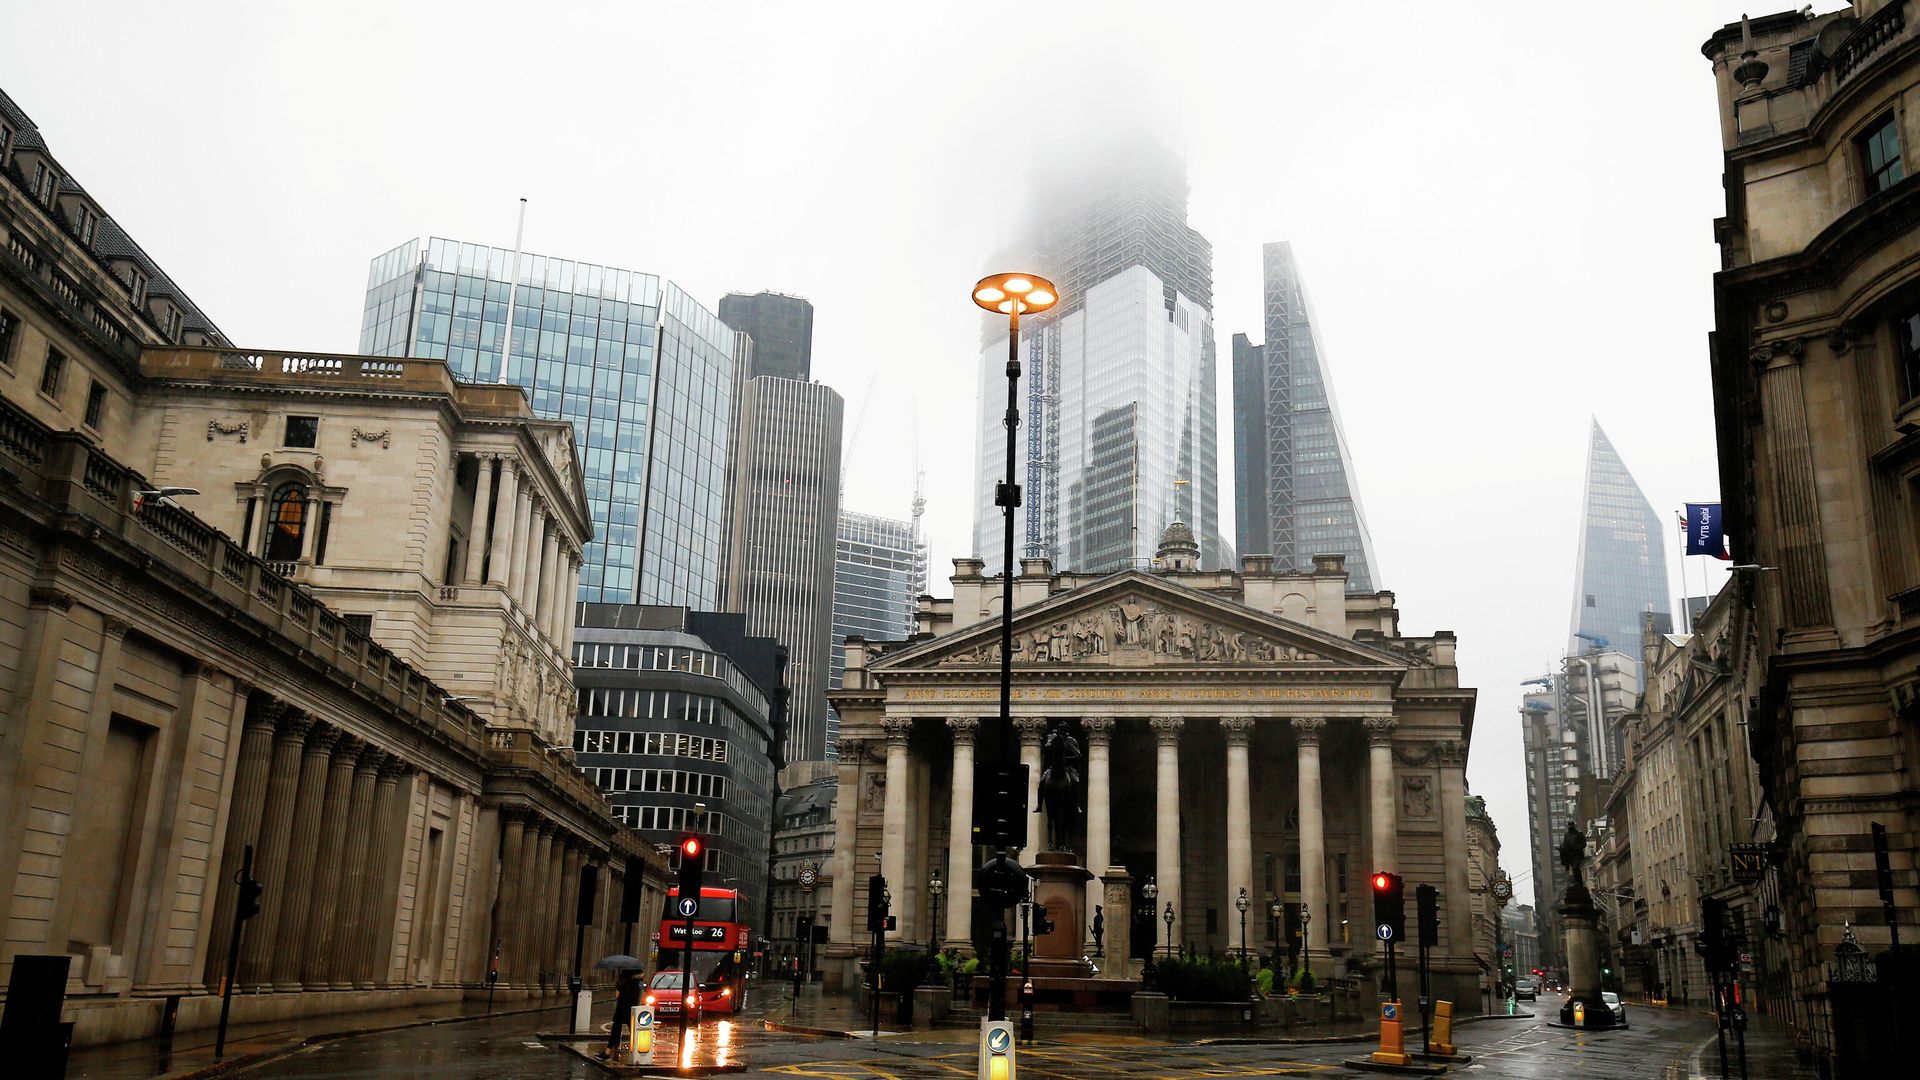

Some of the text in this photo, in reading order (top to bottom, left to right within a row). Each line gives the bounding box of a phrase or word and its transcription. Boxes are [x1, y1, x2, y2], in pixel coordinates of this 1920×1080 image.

[1700, 507, 1712, 539] VTB Capital
[904, 689, 937, 699] ANNO
[1140, 689, 1173, 699] ANNO
[1179, 689, 1241, 698] VICTORIAE
[711, 927, 723, 937] 26
